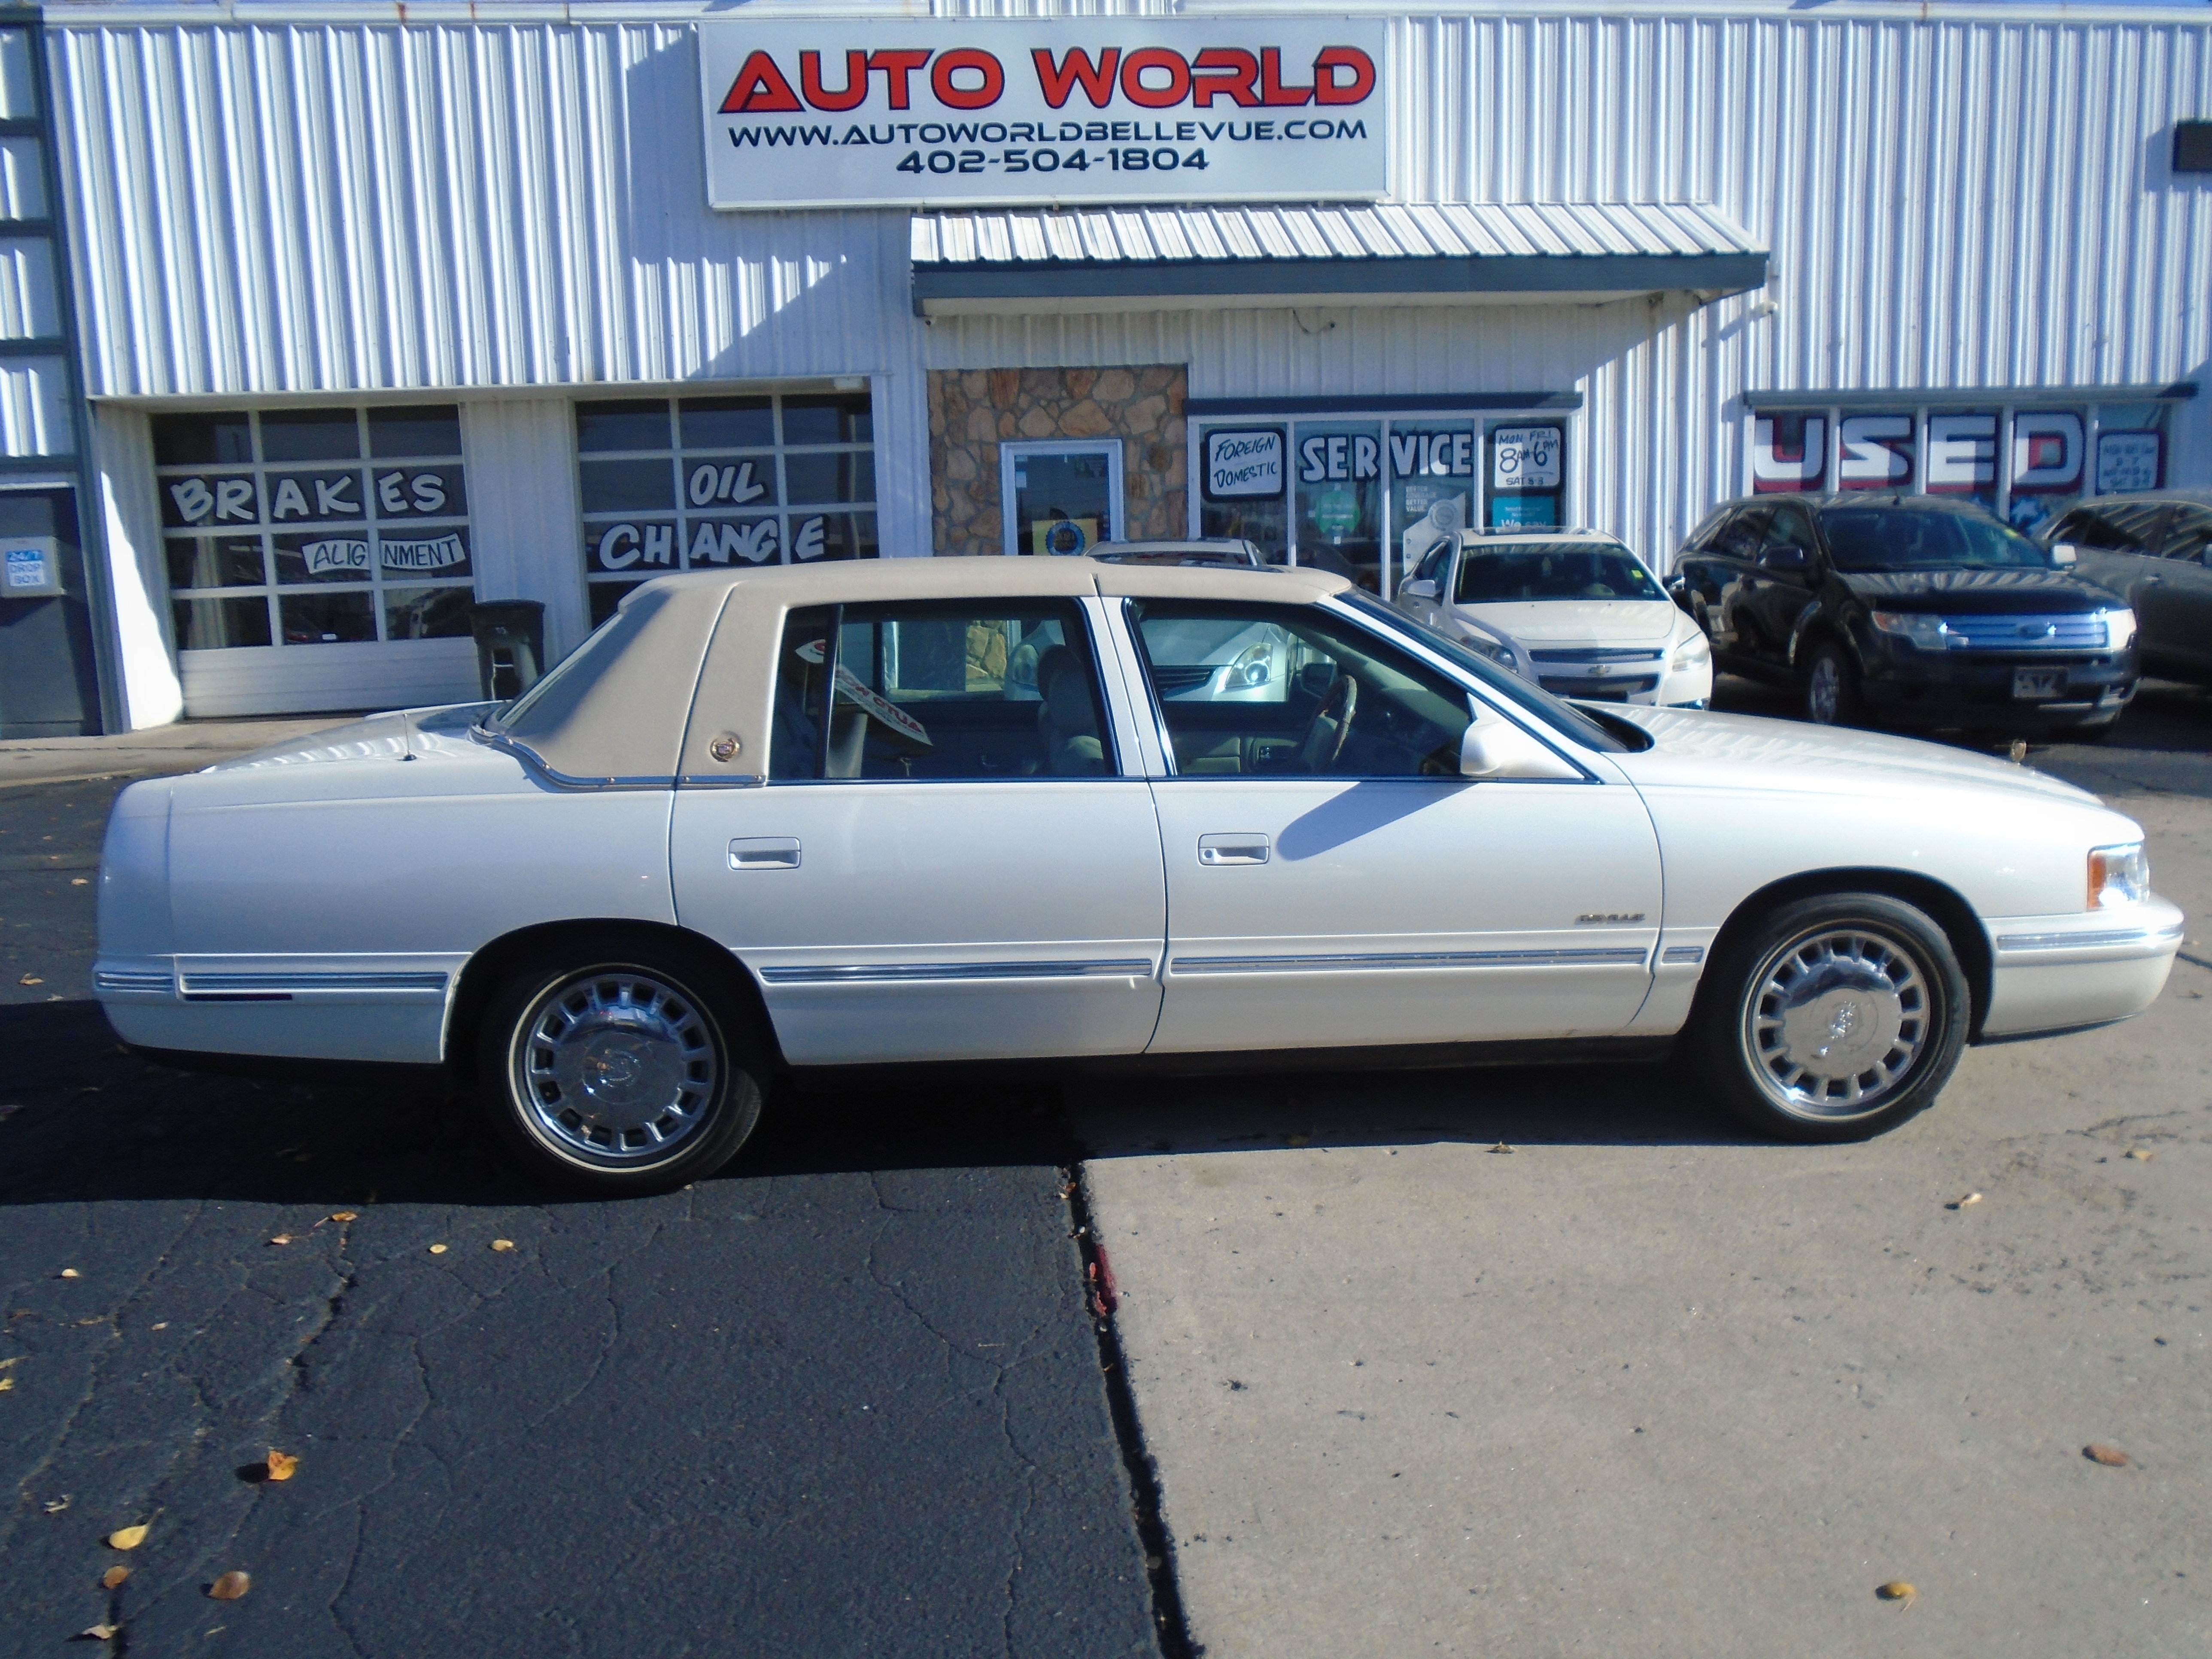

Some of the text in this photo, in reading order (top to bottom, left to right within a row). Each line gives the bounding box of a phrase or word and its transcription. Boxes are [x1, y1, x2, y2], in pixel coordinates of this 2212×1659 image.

[717, 46, 1376, 113] AUTO WORLD
[727, 119, 1367, 147] WWW.AUTOWORLDBELLEVUE.COM
[896, 147, 1210, 174] 402-504-1804
[1215, 436, 1276, 462] FOREIGN
[1498, 434, 1523, 445] MON
[1754, 413, 2084, 492] USED
[1301, 431, 1473, 483] SERVICE
[689, 461, 766, 506] OIL
[1213, 461, 1278, 488] DOMESTIC
[1506, 476, 1525, 486] SAT
[170, 471, 447, 523] BRAKES
[313, 538, 457, 569] ALIGNMENT
[599, 515, 825, 569] CHANGE
